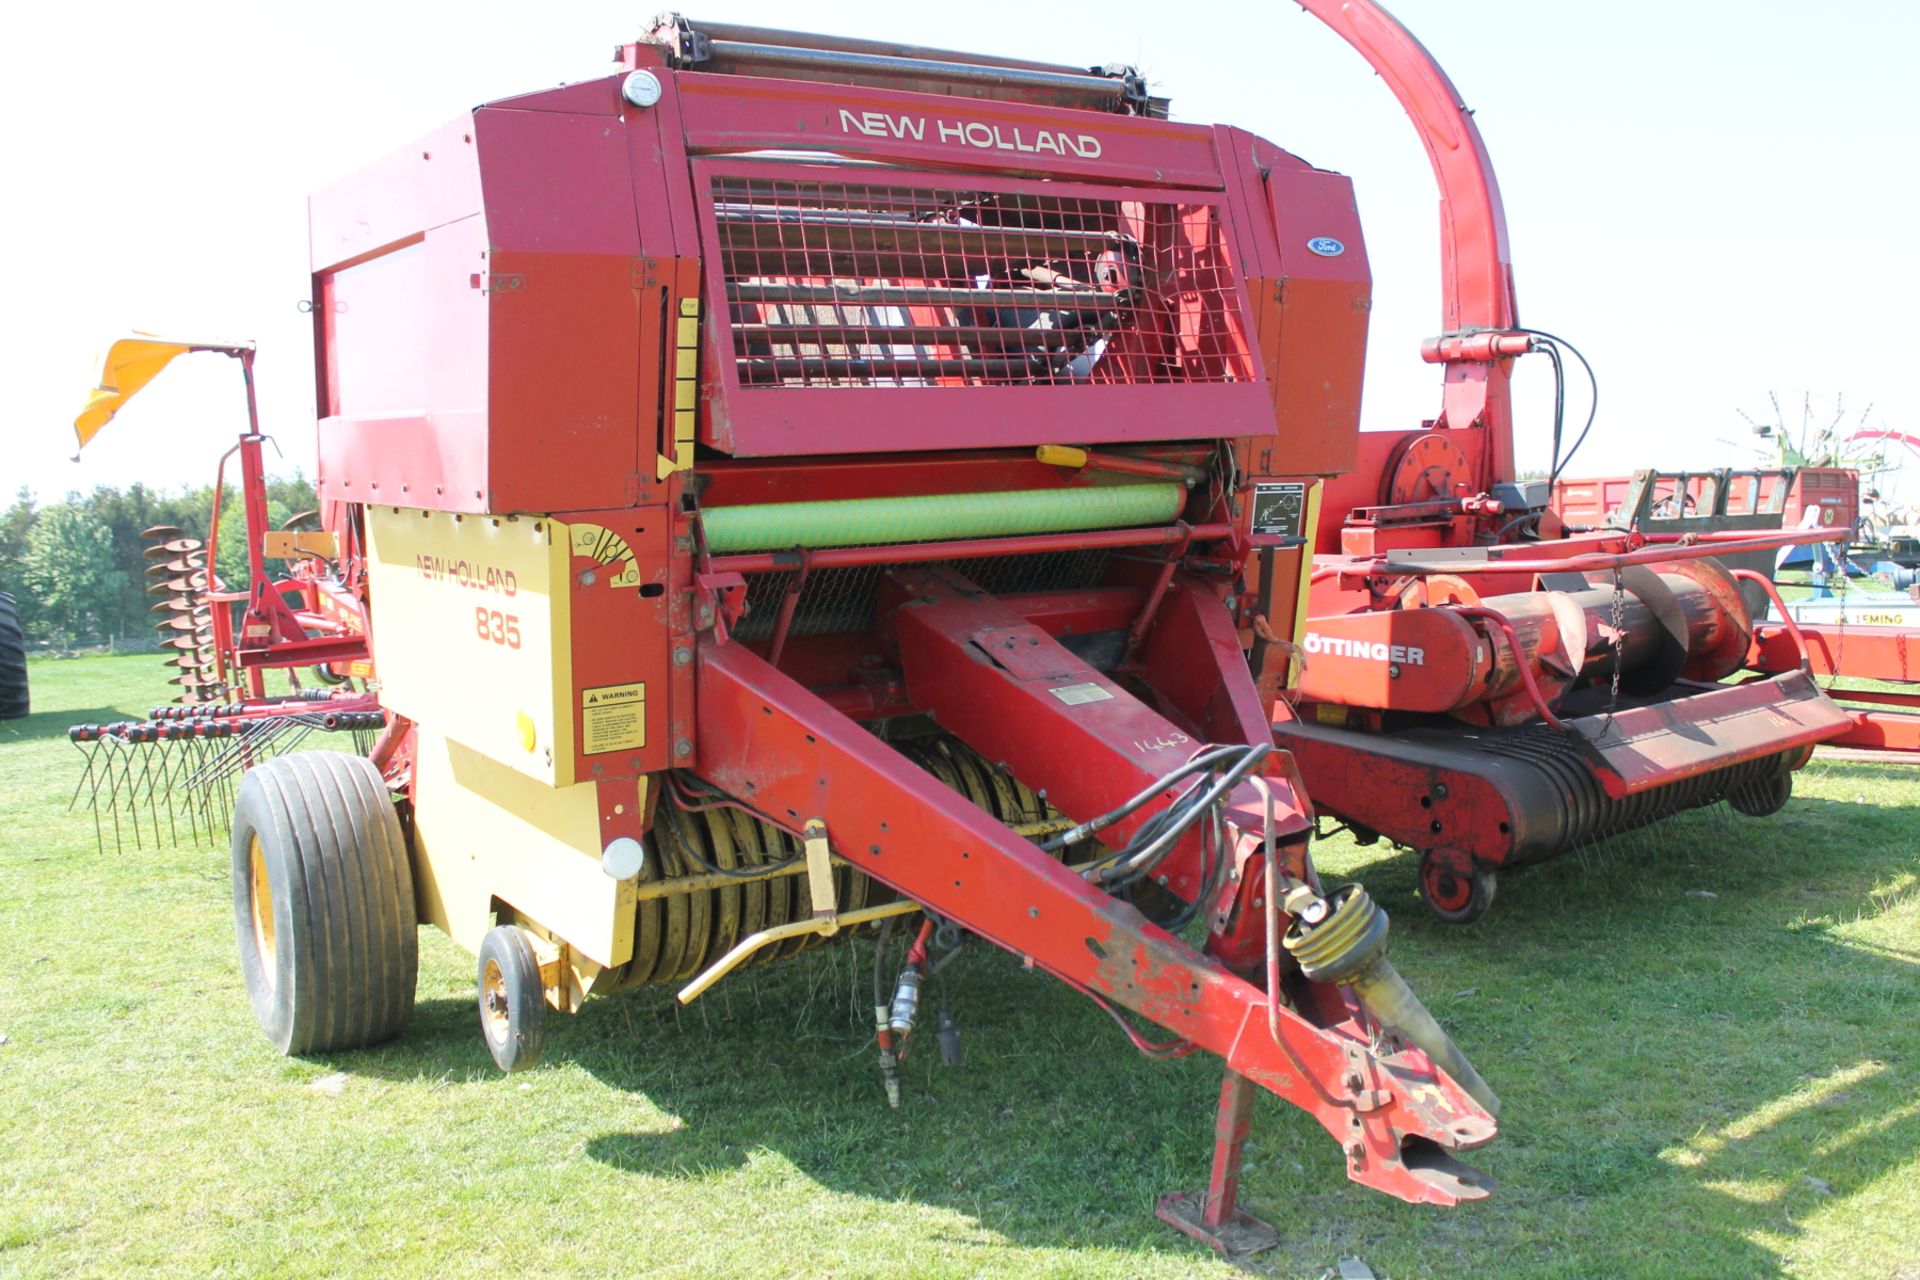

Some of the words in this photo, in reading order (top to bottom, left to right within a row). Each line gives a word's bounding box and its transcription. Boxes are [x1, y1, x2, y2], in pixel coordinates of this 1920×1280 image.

[839, 109, 925, 140] NEW
[937, 120, 1101, 159] HOLLAND
[417, 554, 444, 581] NEW
[448, 560, 517, 597] HOLLAND
[476, 607, 520, 650] 835
[602, 690, 638, 700] WARNING
[1134, 733, 1189, 752] 1443
